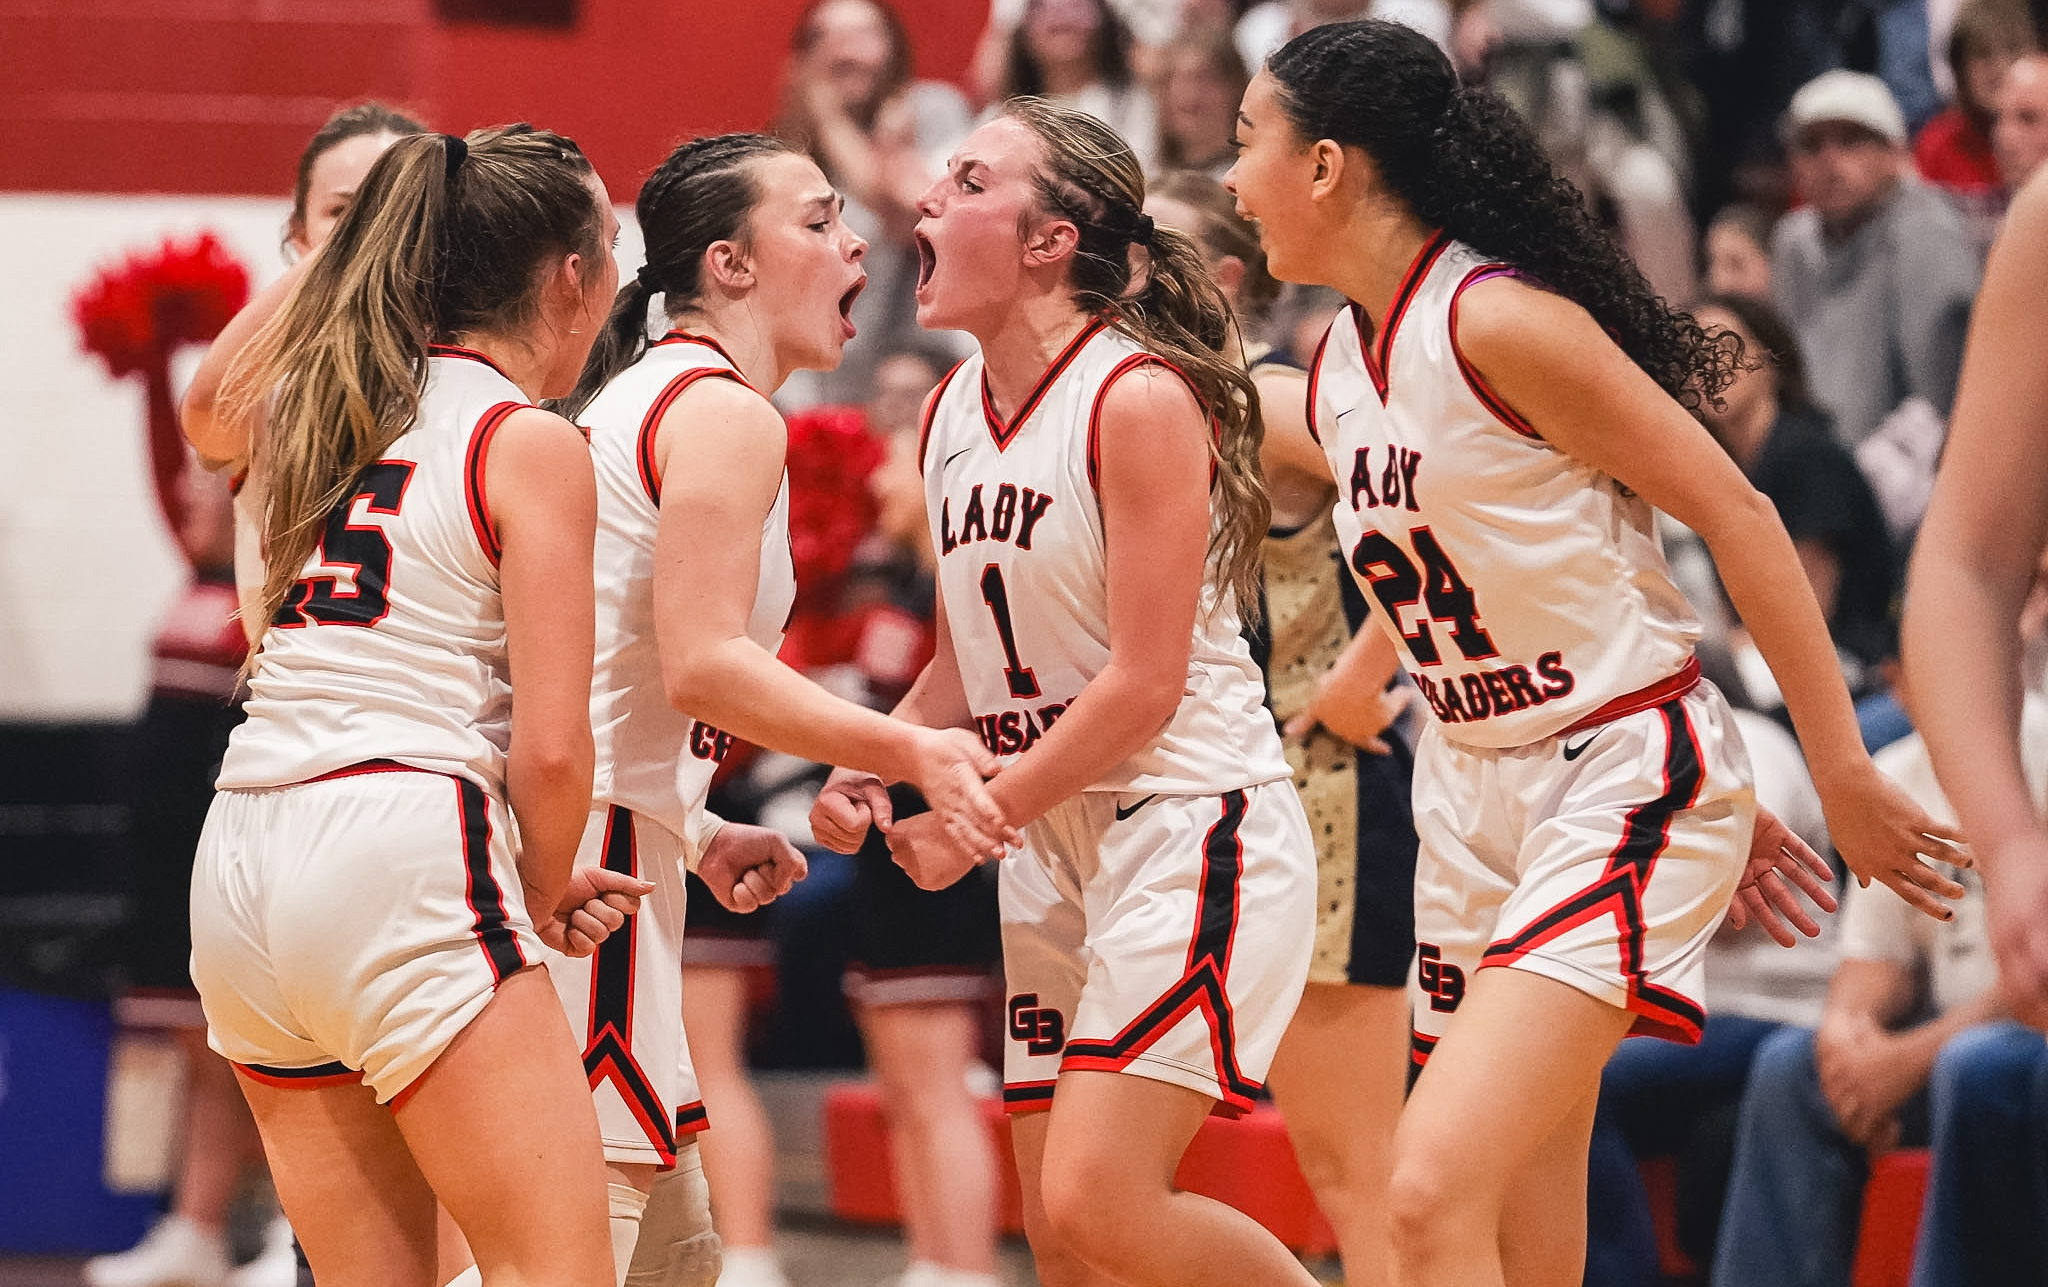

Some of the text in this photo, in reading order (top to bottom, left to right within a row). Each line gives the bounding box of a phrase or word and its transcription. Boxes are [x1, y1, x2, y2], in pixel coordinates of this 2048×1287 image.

[269, 459, 418, 629] 5
[942, 482, 1054, 557] LADY
[980, 562, 1042, 698] 1
[1353, 524, 1500, 667] 24
[1009, 993, 1065, 1057] GB
